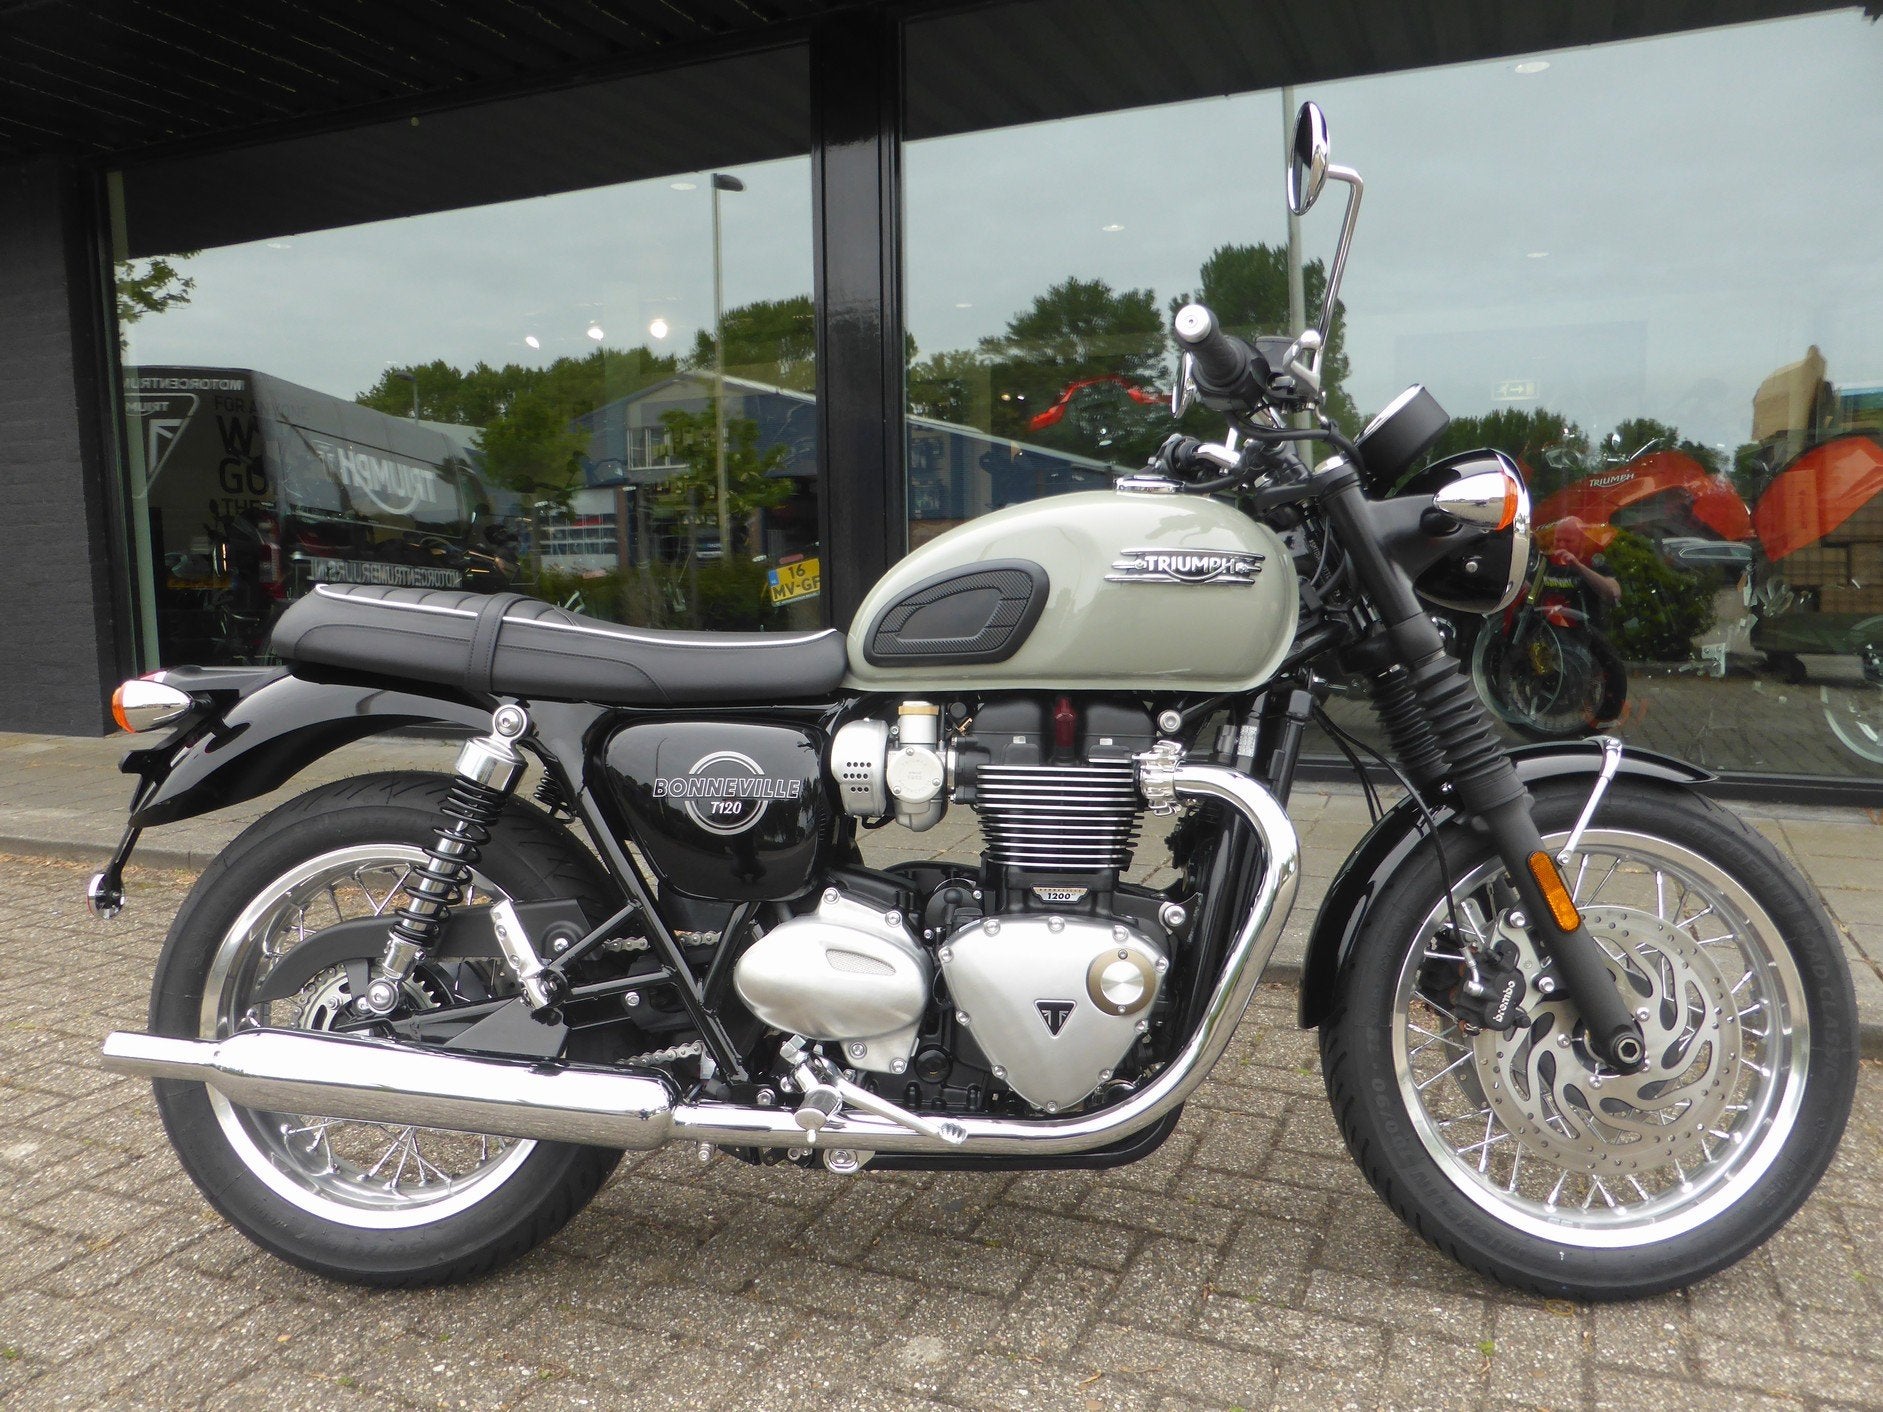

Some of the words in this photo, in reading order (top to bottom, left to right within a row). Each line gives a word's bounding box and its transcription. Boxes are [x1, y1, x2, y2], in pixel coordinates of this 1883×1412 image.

[1589, 473, 1635, 487] TRIUMPH
[788, 563, 805, 579] 16
[1145, 555, 1235, 574] TRIUMPH
[653, 778, 800, 798] BONNEVILLE
[711, 801, 742, 814] T120
[1047, 892, 1071, 900] 1200
[1492, 980, 1516, 1023] brembo
[1791, 918, 1828, 981] ROAD
[1817, 984, 1839, 1080] CLASSIC
